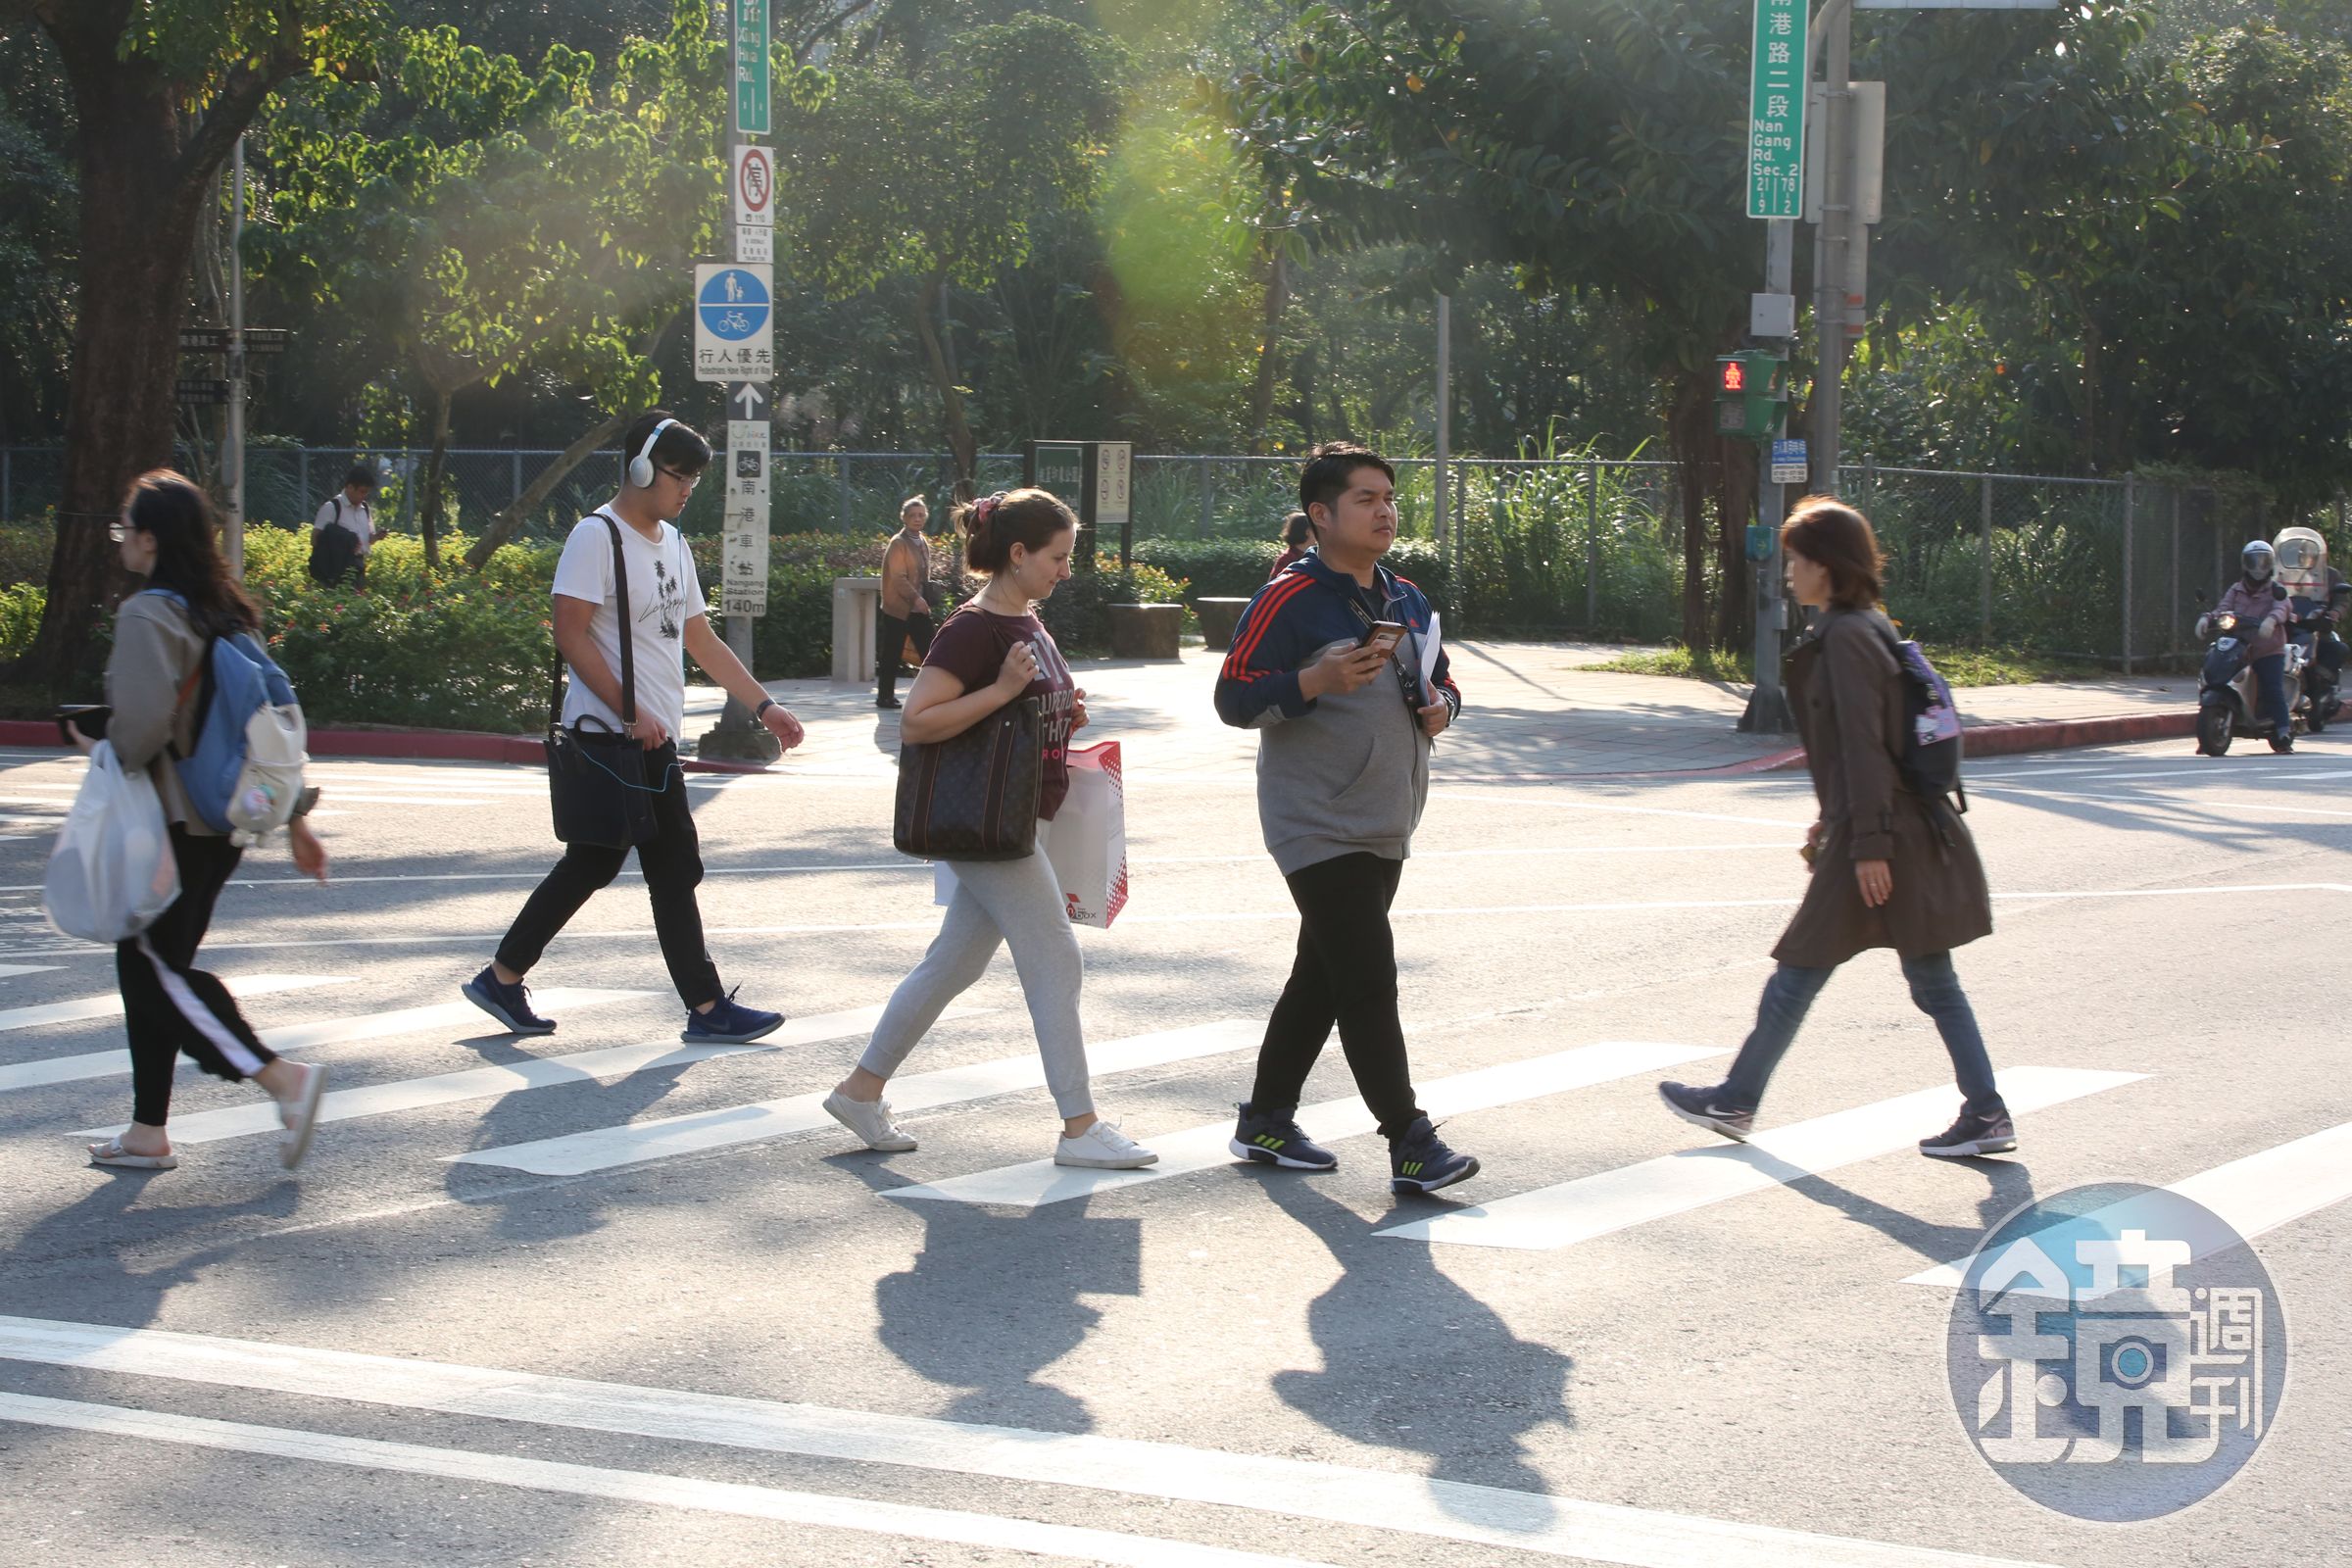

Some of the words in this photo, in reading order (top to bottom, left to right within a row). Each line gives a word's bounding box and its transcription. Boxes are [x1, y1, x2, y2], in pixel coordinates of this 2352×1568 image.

[738, 27, 760, 47] Xing
[1753, 120, 1783, 132] Nan
[1753, 134, 1791, 151] Gang
[1753, 149, 1776, 162] Rd.
[1753, 164, 1784, 176] Sec.
[1788, 164, 1798, 176] 2
[1756, 176, 1769, 192] 21
[1781, 177, 1795, 192] 78
[1758, 199, 1766, 214] 9
[1784, 200, 1791, 214] 2
[699, 348, 770, 364] 行人優先
[738, 480, 756, 576] 南港車站
[726, 579, 765, 588] Nangang
[724, 599, 764, 613] 140m
